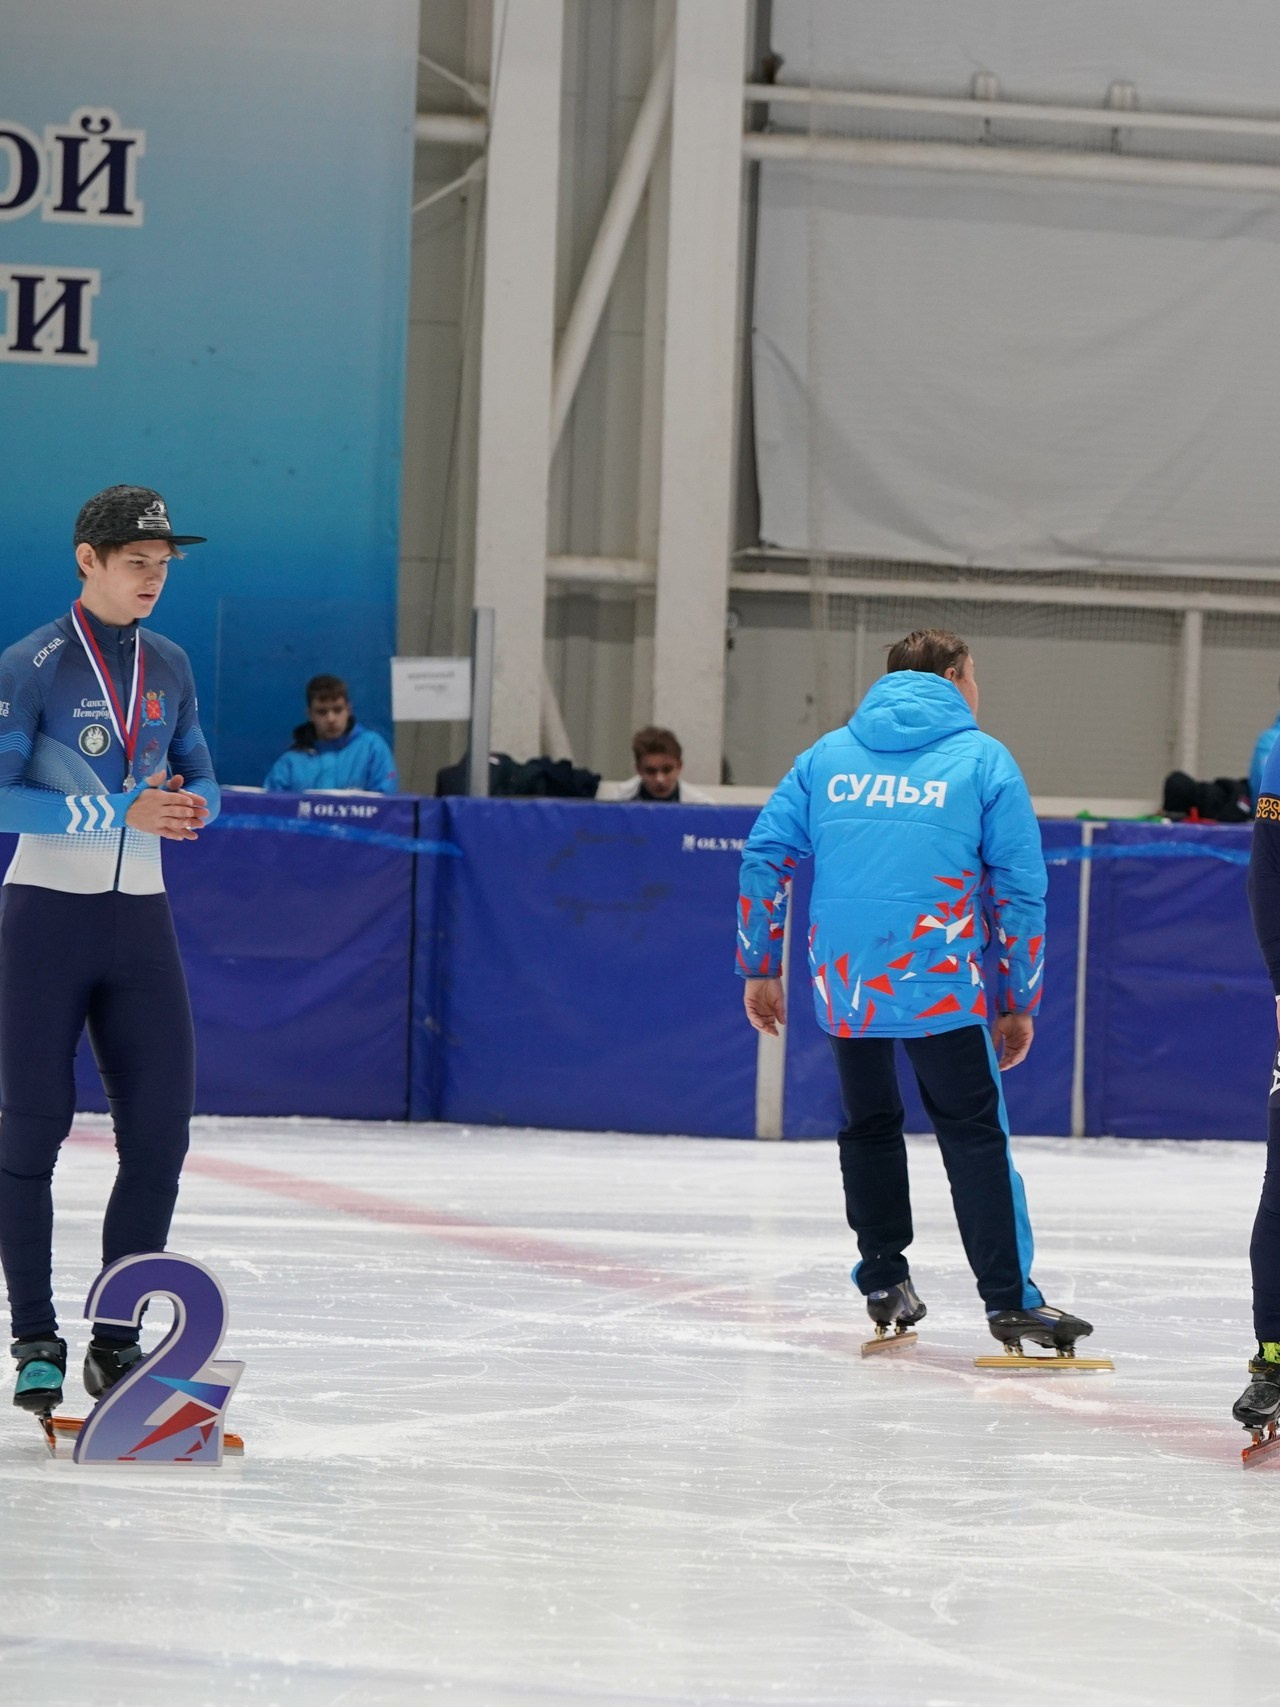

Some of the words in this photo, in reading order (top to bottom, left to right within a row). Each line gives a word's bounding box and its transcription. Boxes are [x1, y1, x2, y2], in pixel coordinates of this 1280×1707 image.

[827, 773, 948, 808] СУДЬЯ
[314, 803, 378, 818] OLYMP
[697, 837, 747, 851] OLYM
[76, 1254, 234, 1464] 2
